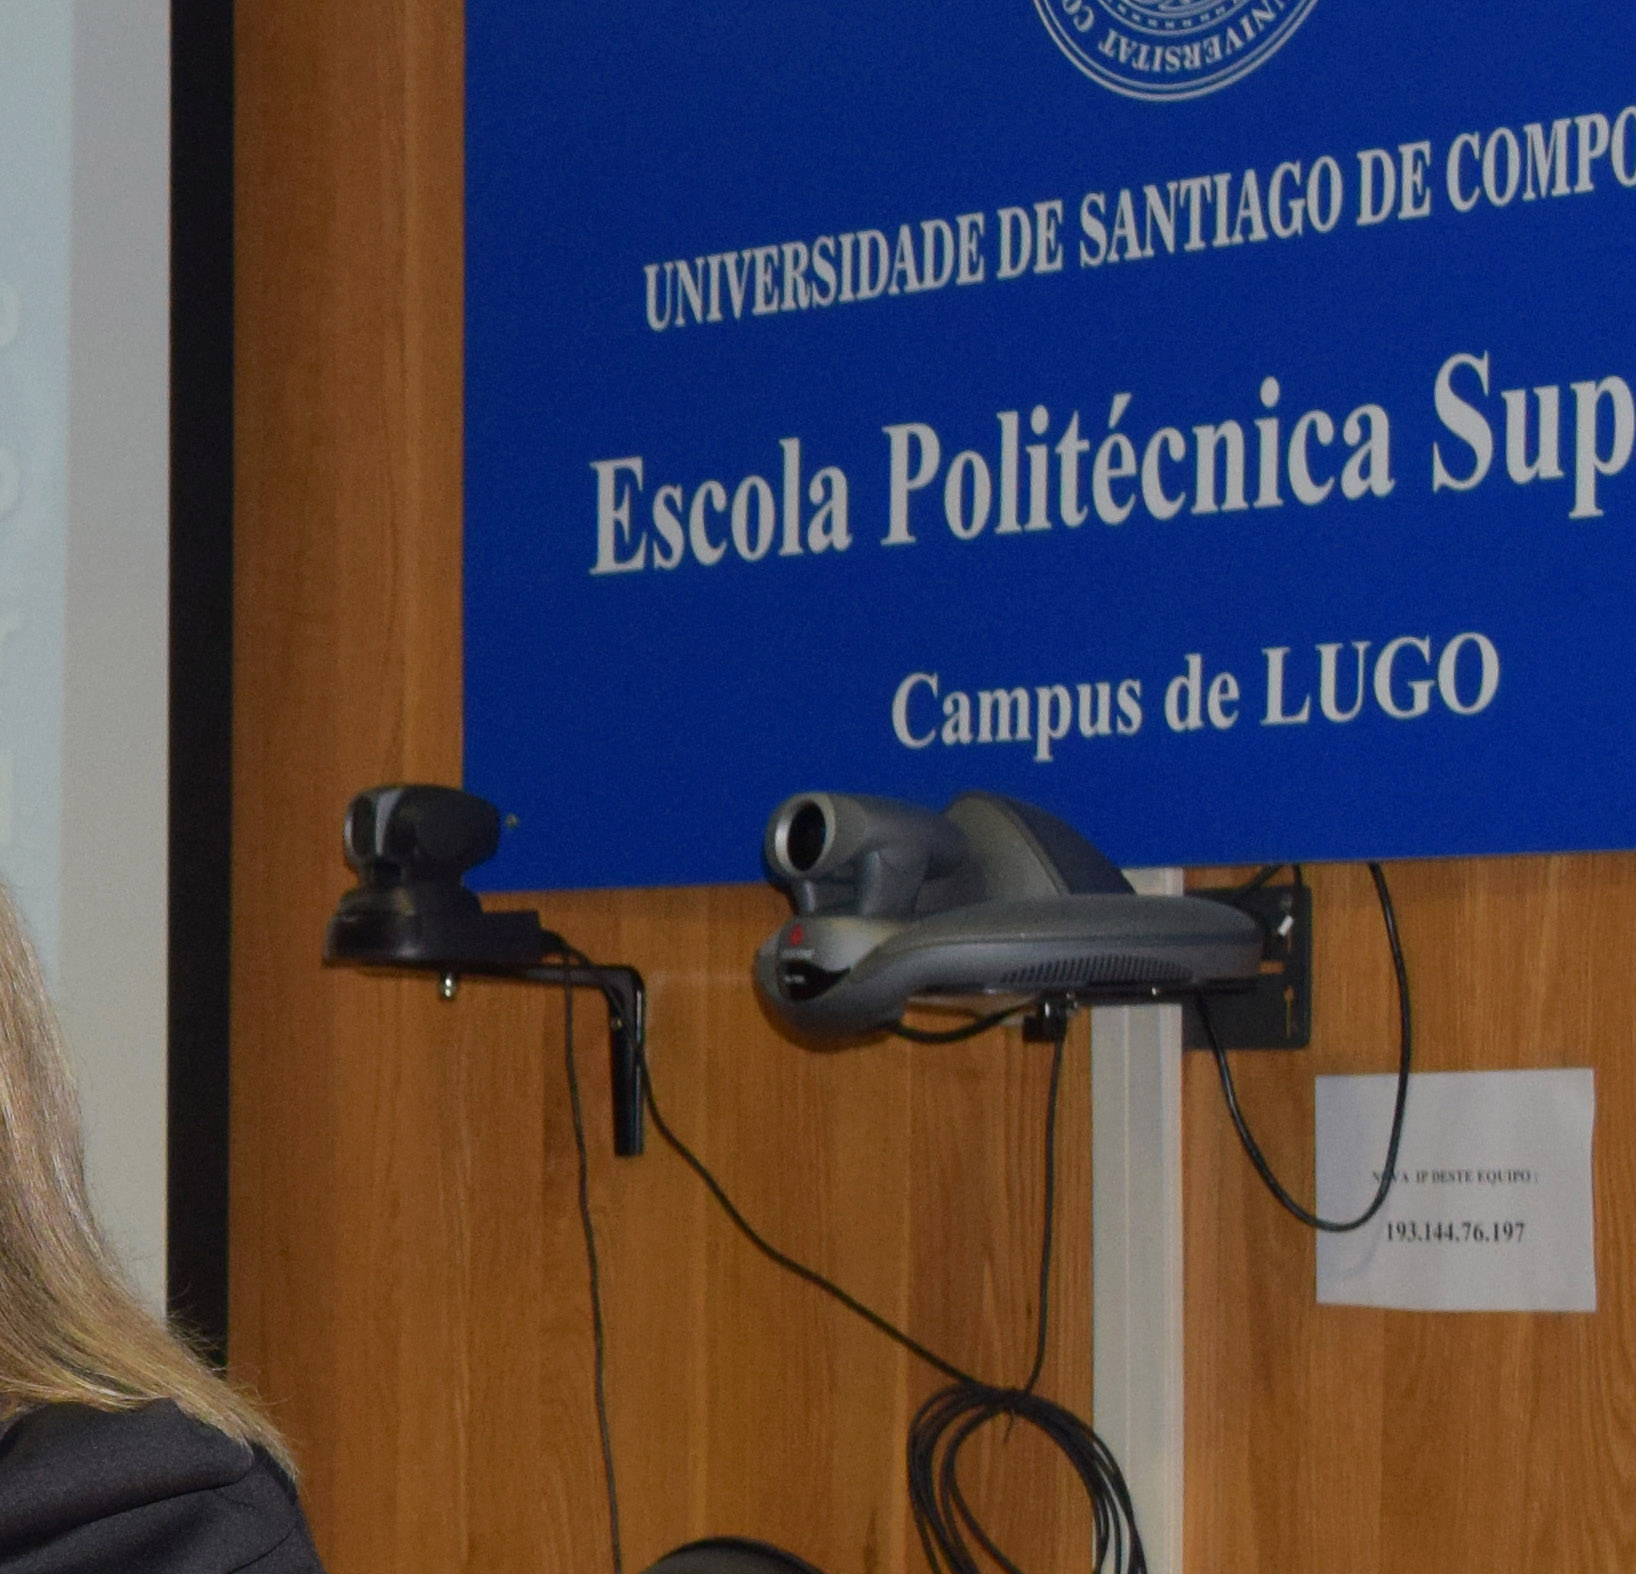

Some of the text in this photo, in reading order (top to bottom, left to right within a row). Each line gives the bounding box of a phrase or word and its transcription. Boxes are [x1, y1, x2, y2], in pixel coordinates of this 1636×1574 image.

[645, 213, 985, 331] UNIVERSIDADE
[998, 200, 1064, 279] DE
[1081, 157, 1344, 267] SANTIAGO
[1357, 142, 1432, 226] DE
[590, 350, 1636, 575] Escola Politécnica Sup
[893, 633, 1501, 762] Campus de LUGO
[1387, 1220, 1526, 1243] 193.144.76.197
